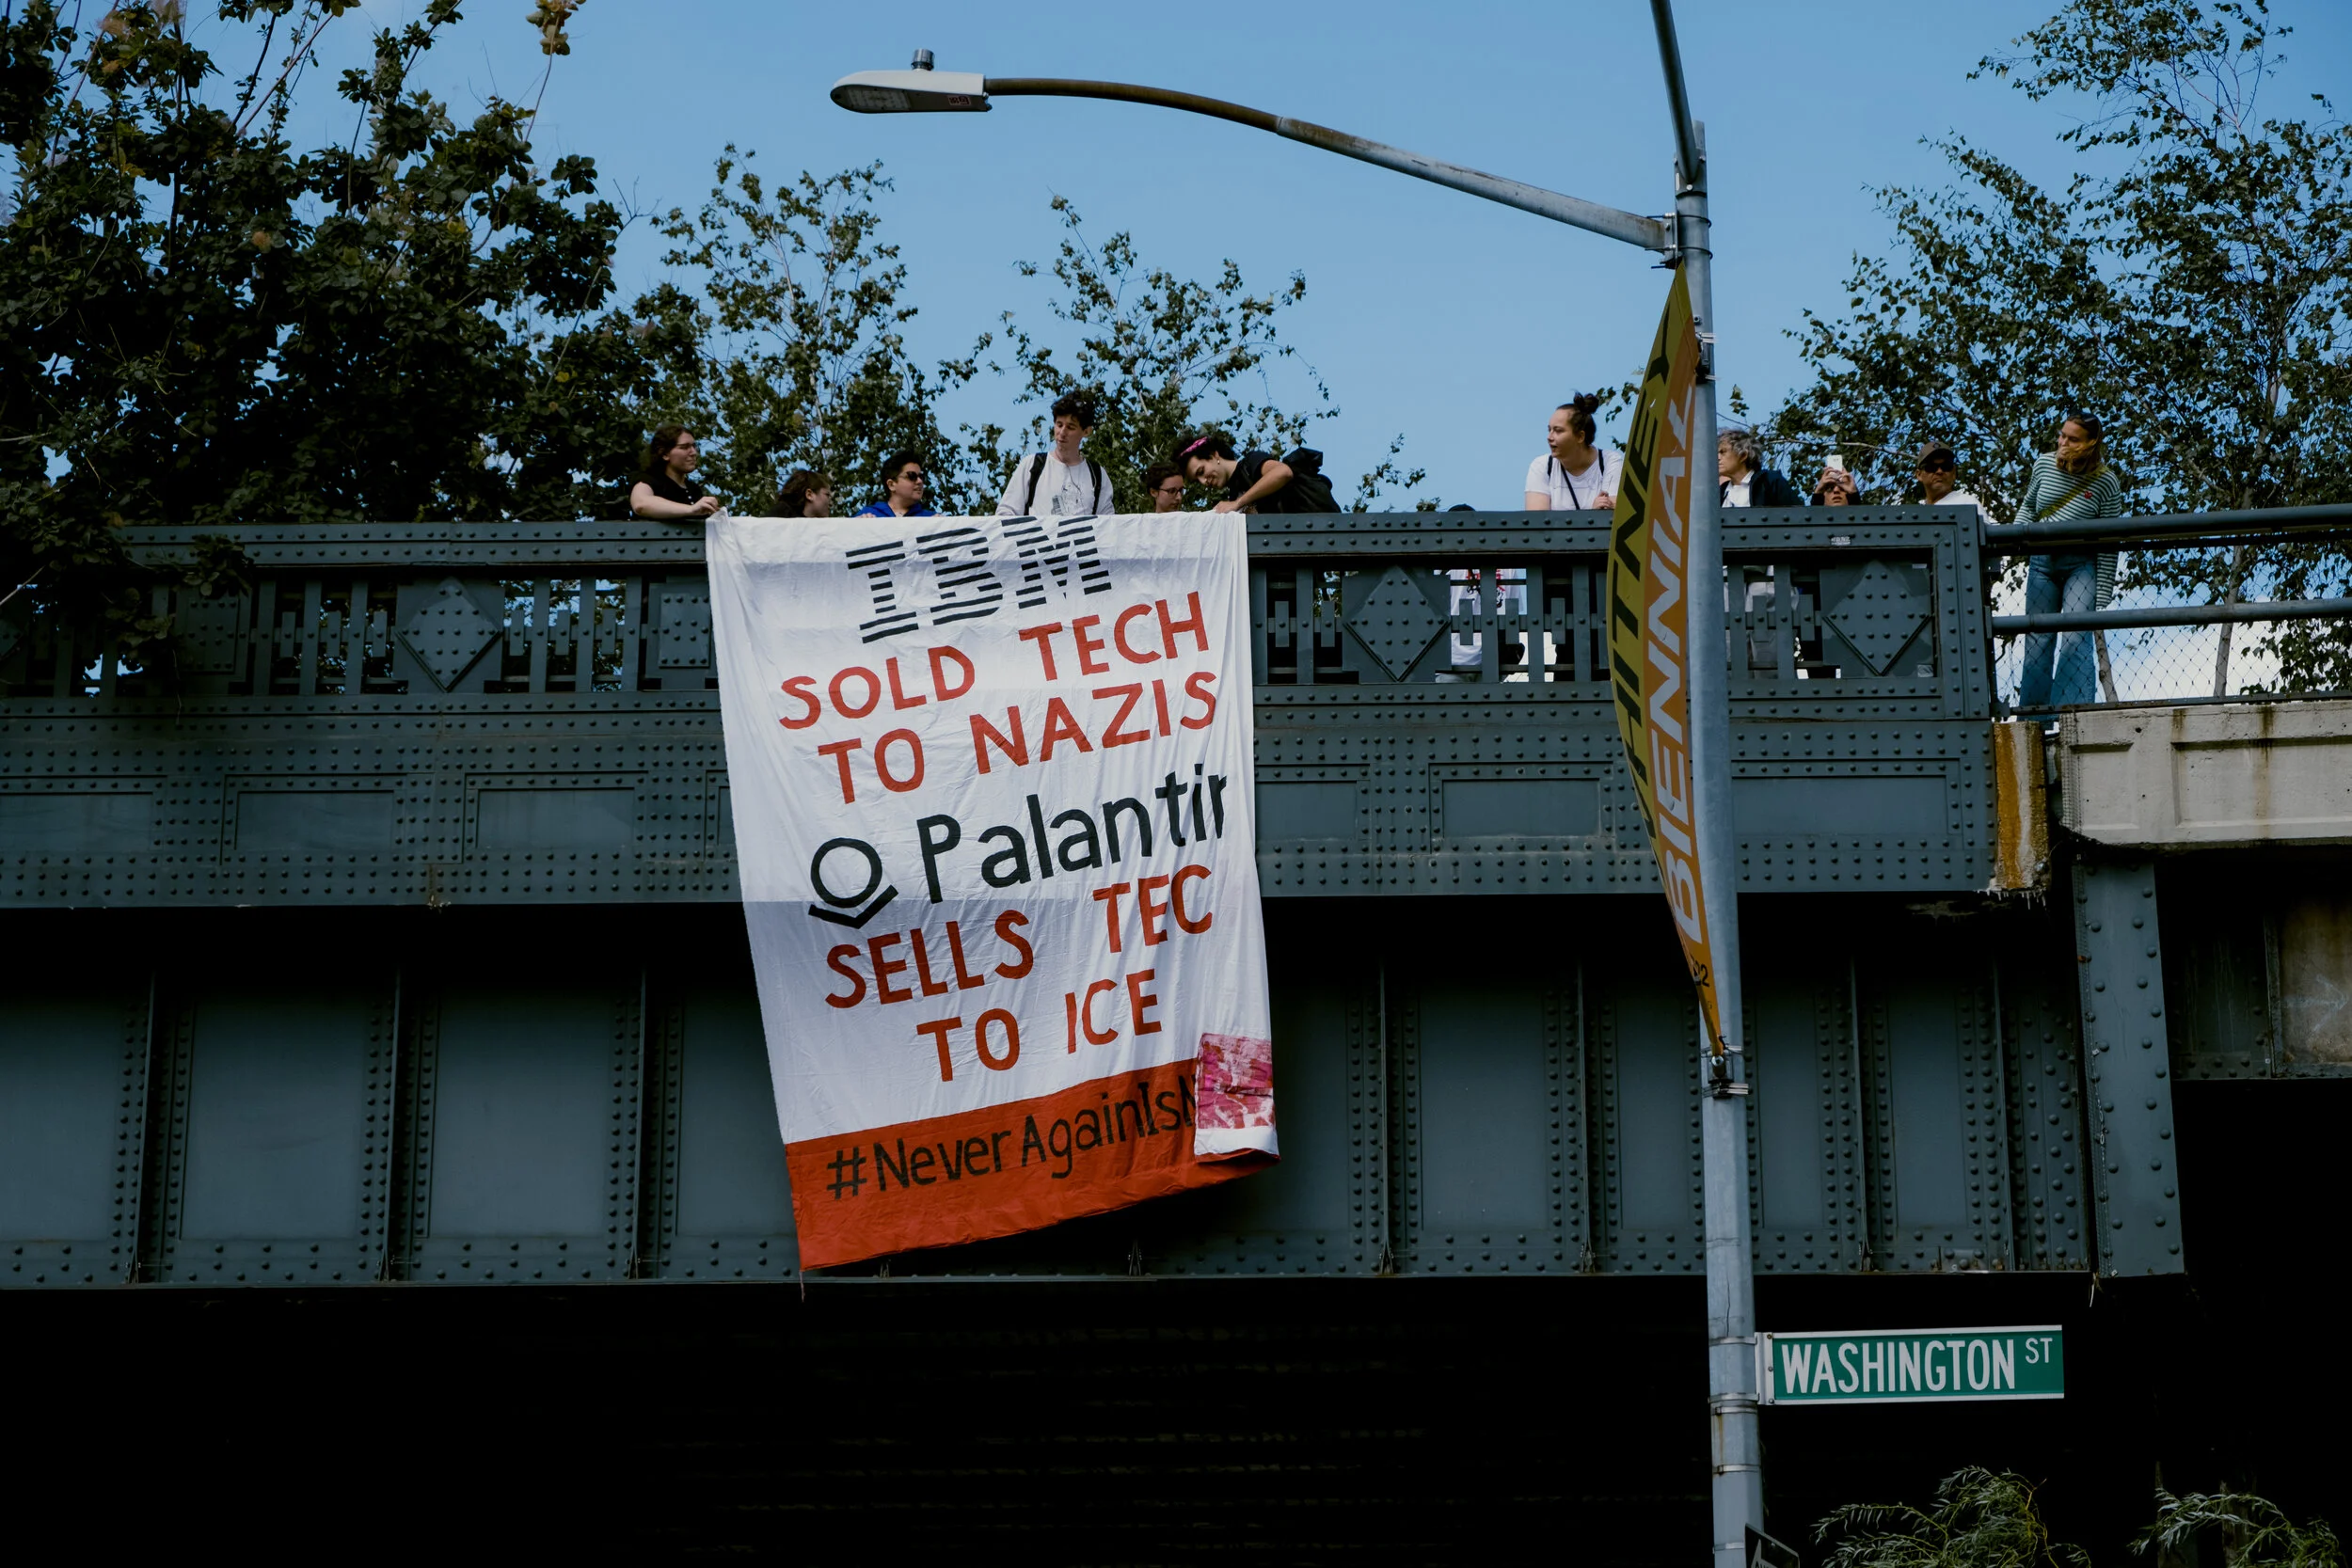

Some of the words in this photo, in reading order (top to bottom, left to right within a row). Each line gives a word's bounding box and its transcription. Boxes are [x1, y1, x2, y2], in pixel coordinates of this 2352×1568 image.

[846, 516, 1111, 643] IBM
[779, 646, 974, 729] SOLD
[1020, 592, 1208, 680] TECH
[1647, 383, 1703, 944] BIENNIAL
[818, 728, 924, 803] TO
[970, 673, 1216, 774] NAZIS
[917, 764, 1226, 904] Palantir
[825, 911, 1033, 1007] SELLS
[1093, 865, 1212, 952] TEC
[917, 1008, 1020, 1082] TO
[1066, 970, 1161, 1053] ICE
[1782, 1339, 2014, 1393] WASHINGTON
[2025, 1338, 2053, 1364] ST
